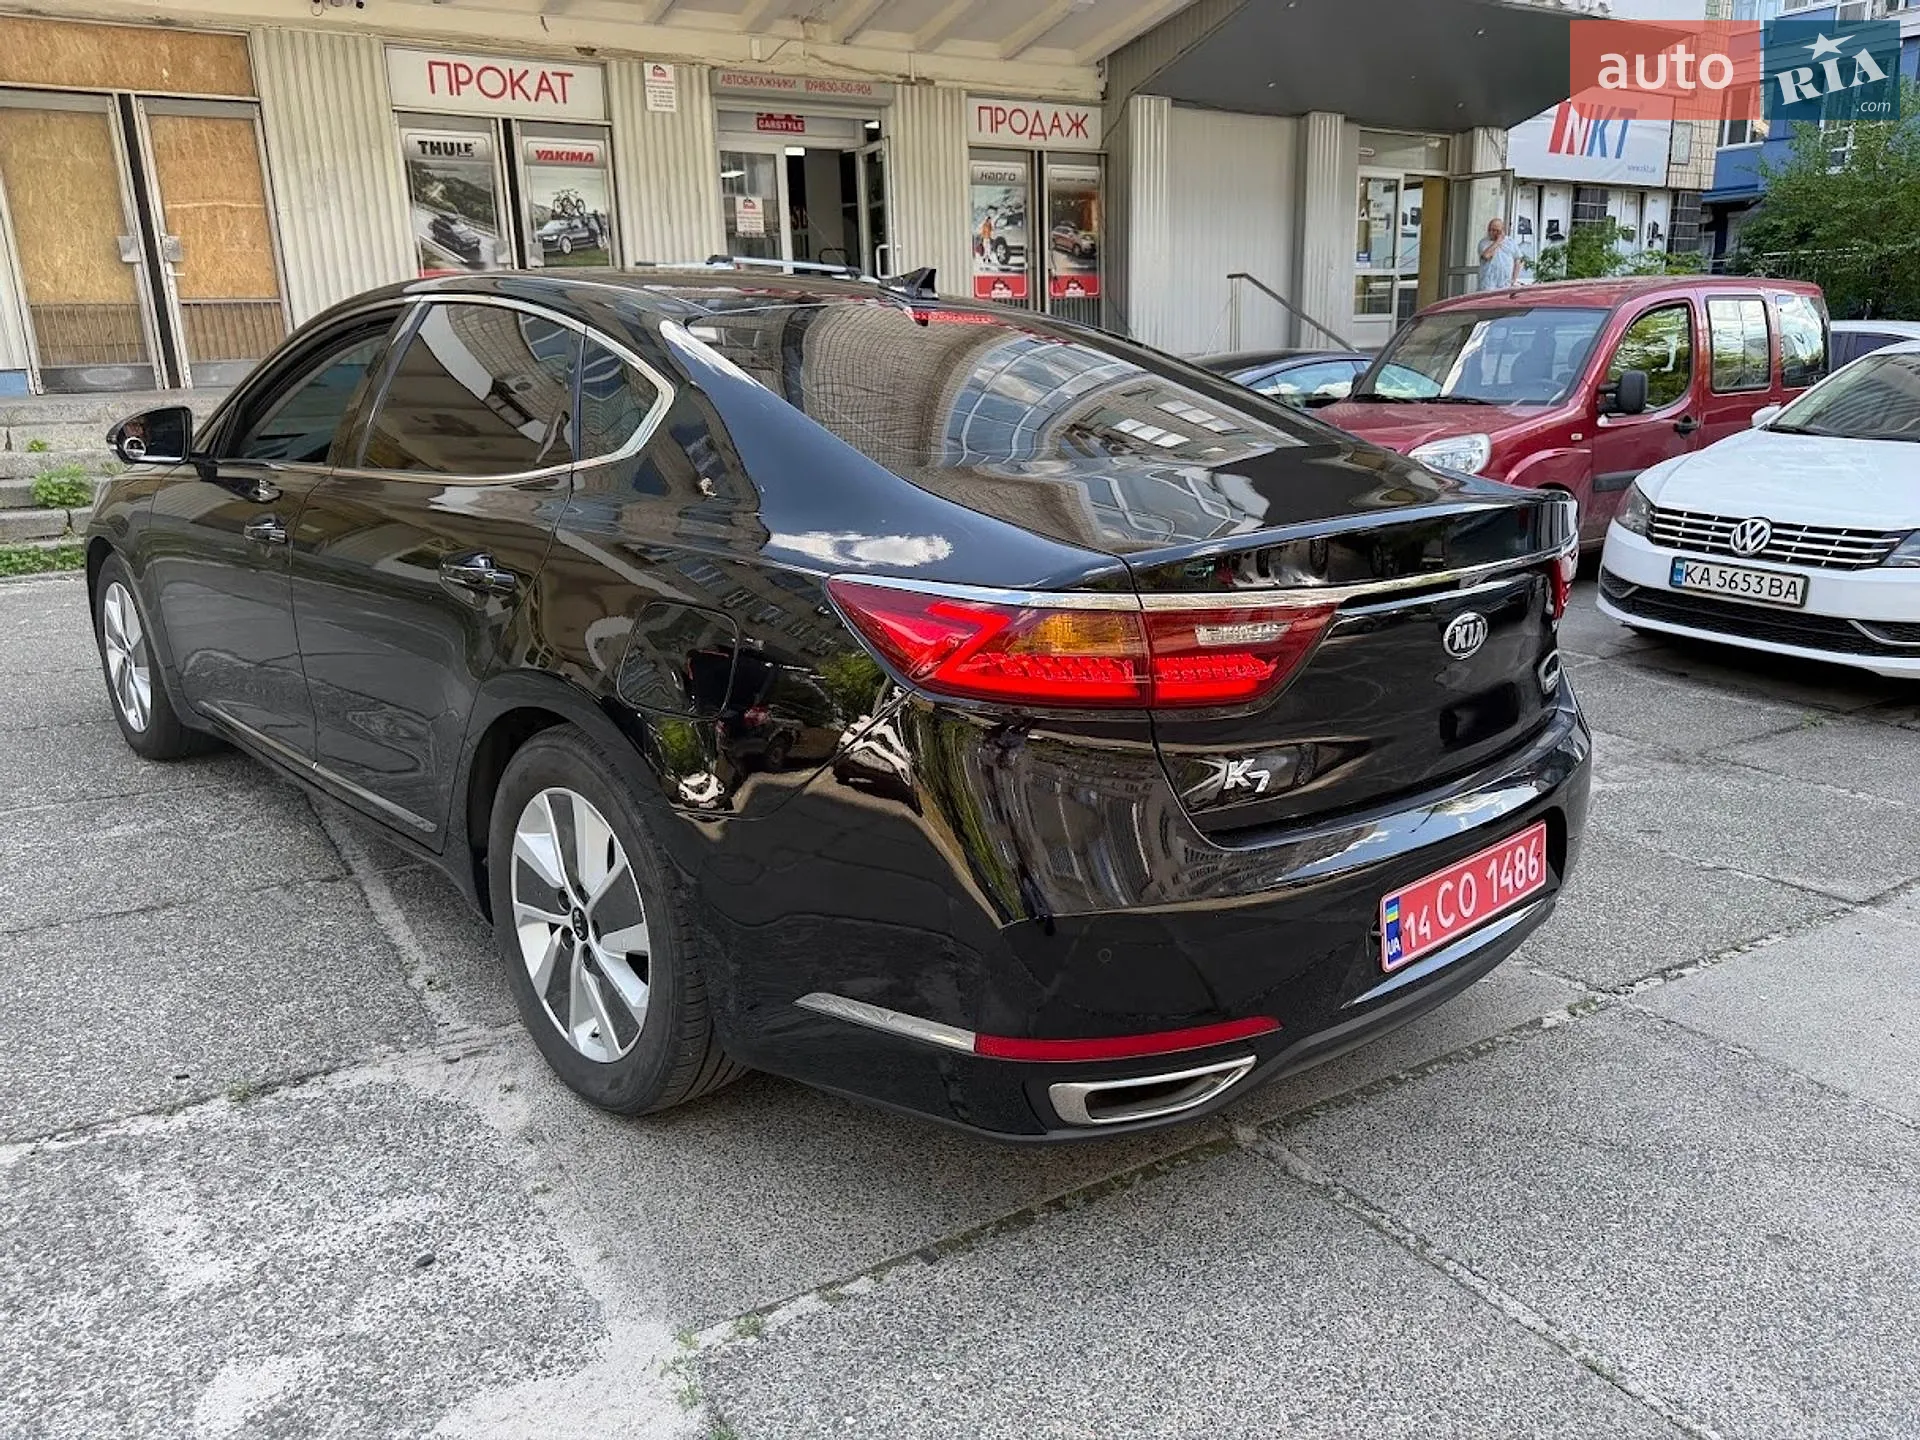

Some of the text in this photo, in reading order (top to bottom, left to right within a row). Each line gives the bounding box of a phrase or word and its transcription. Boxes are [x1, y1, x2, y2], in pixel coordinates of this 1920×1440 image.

[427, 60, 574, 104] ПРОКАТ
[720, 74, 797, 89] АВТОБАГАЖНИКИ
[758, 119, 804, 131] CARSTYLE
[977, 105, 1089, 141] ПРОДАЖ
[417, 140, 474, 157] THULE
[535, 149, 595, 163] YAKIMA
[1683, 564, 1798, 600] KA 5653 BA
[1452, 620, 1484, 650] KIA
[1223, 758, 1270, 793] K7
[1404, 837, 1540, 948] 14 CO 1486
[1387, 937, 1401, 956] UA
